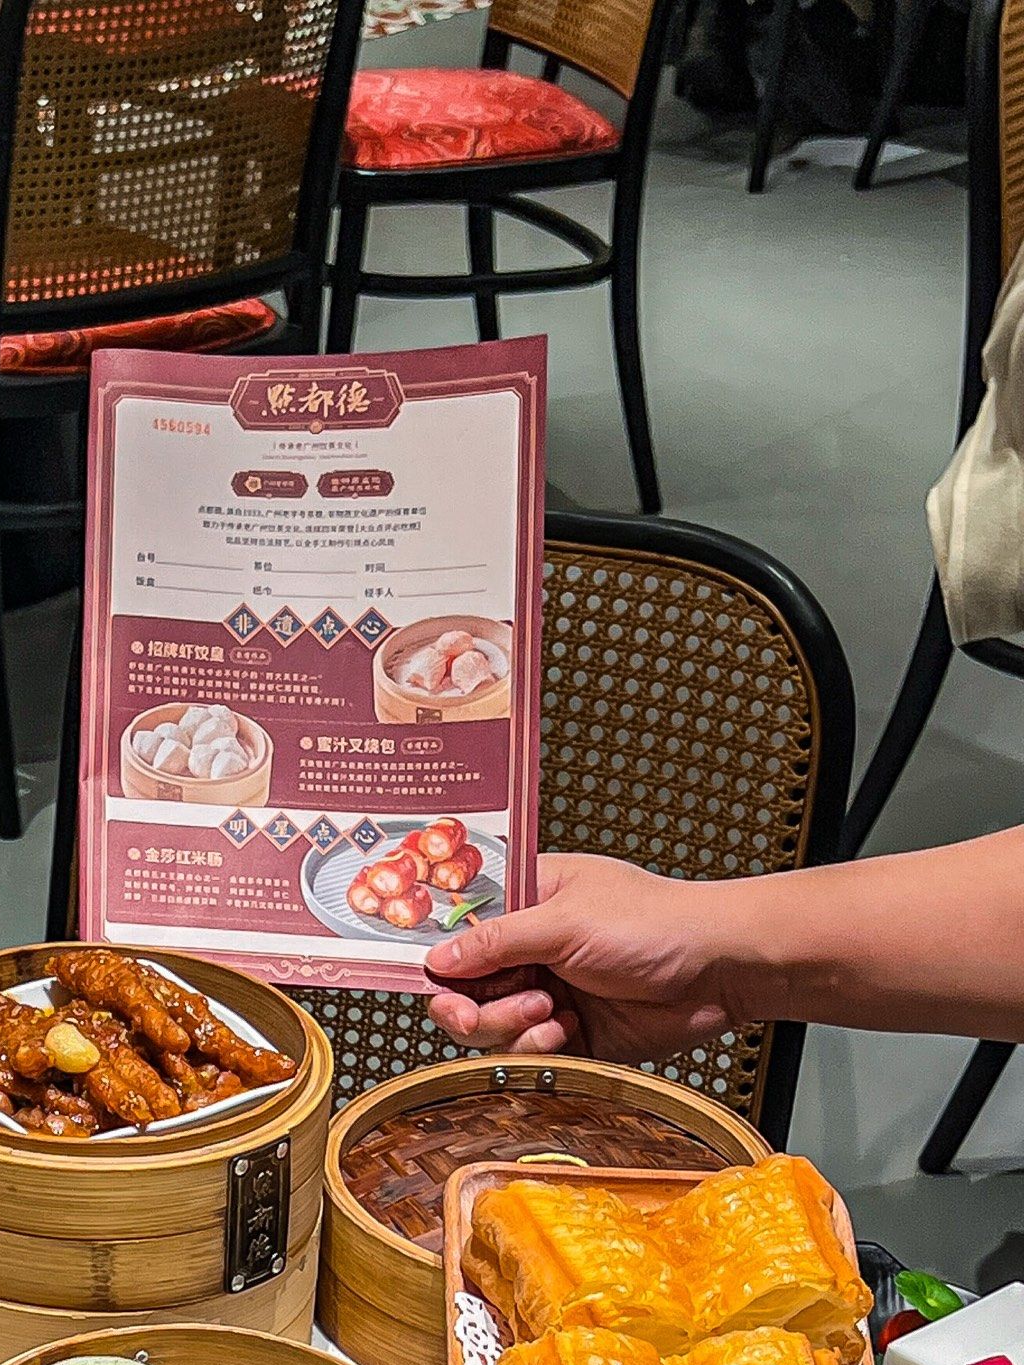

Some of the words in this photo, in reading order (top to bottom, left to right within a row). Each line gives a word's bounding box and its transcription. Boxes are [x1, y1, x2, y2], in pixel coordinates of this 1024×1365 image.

[364, 563, 386, 574] 时间
[316, 736, 396, 755] 蜜汁叉烧包
